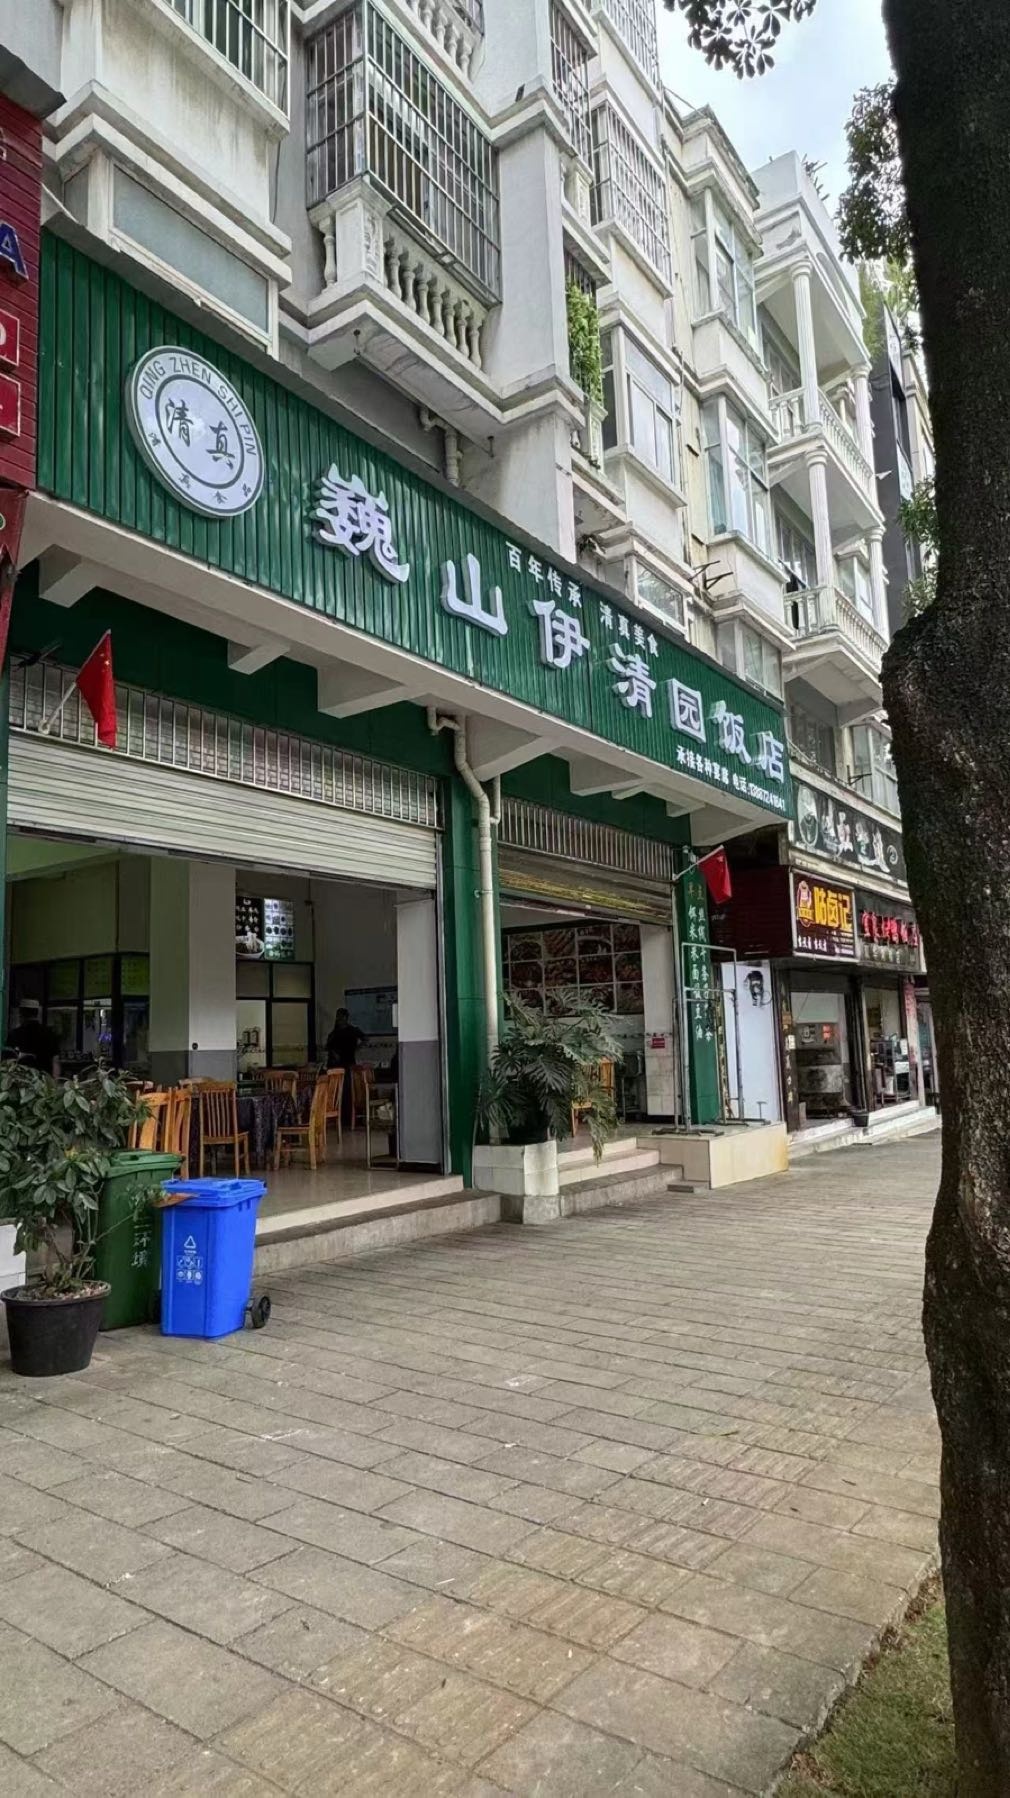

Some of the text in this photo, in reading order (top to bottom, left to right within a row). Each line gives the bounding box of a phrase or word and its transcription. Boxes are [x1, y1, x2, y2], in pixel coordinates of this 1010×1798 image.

[140, 356, 257, 456] QING ZHEN SHI PIN
[165, 397, 236, 471] 清真
[505, 540, 659, 658] 百年传承 清真美食
